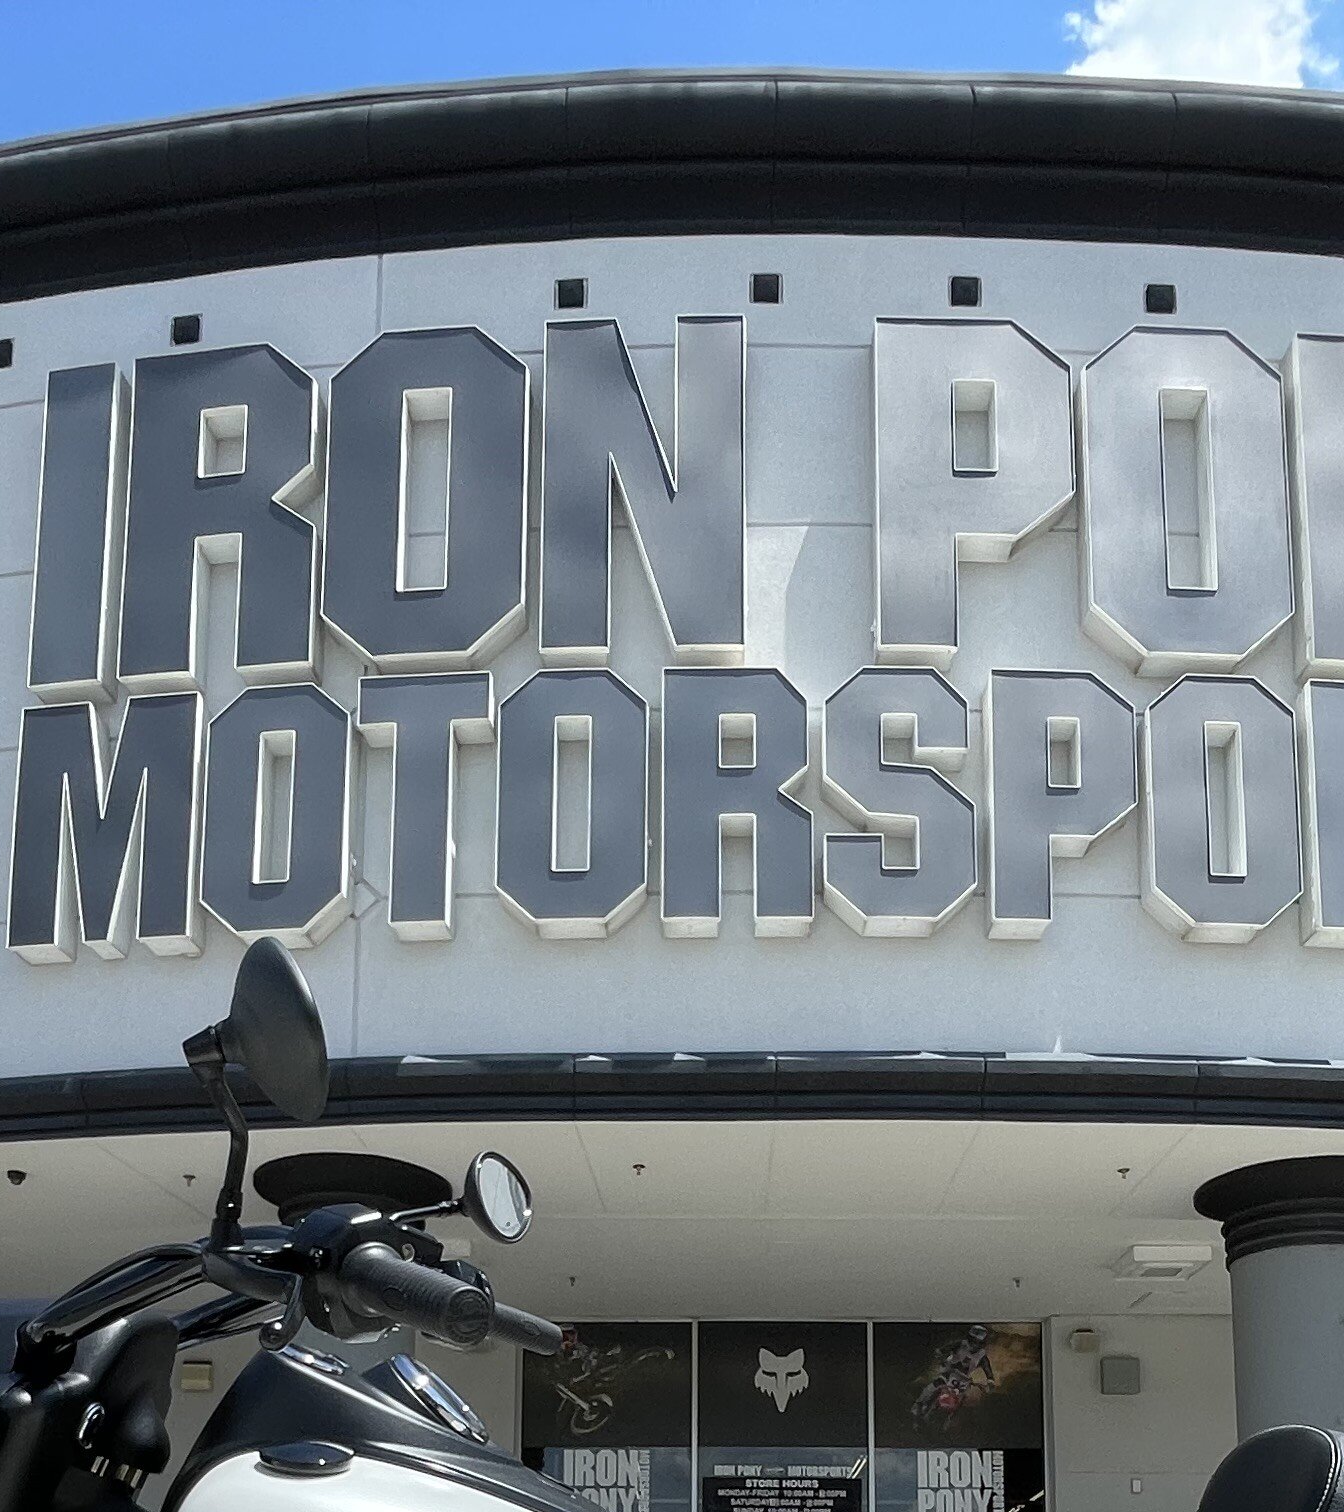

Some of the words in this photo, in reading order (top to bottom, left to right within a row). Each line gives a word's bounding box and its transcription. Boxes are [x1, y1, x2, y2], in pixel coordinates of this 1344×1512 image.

[27, 315, 746, 702] IRON
[563, 1448, 639, 1487] IRON
[745, 1479, 780, 1488] STORE
[782, 1479, 819, 1488] HOURS
[917, 1450, 993, 1487] IRON
